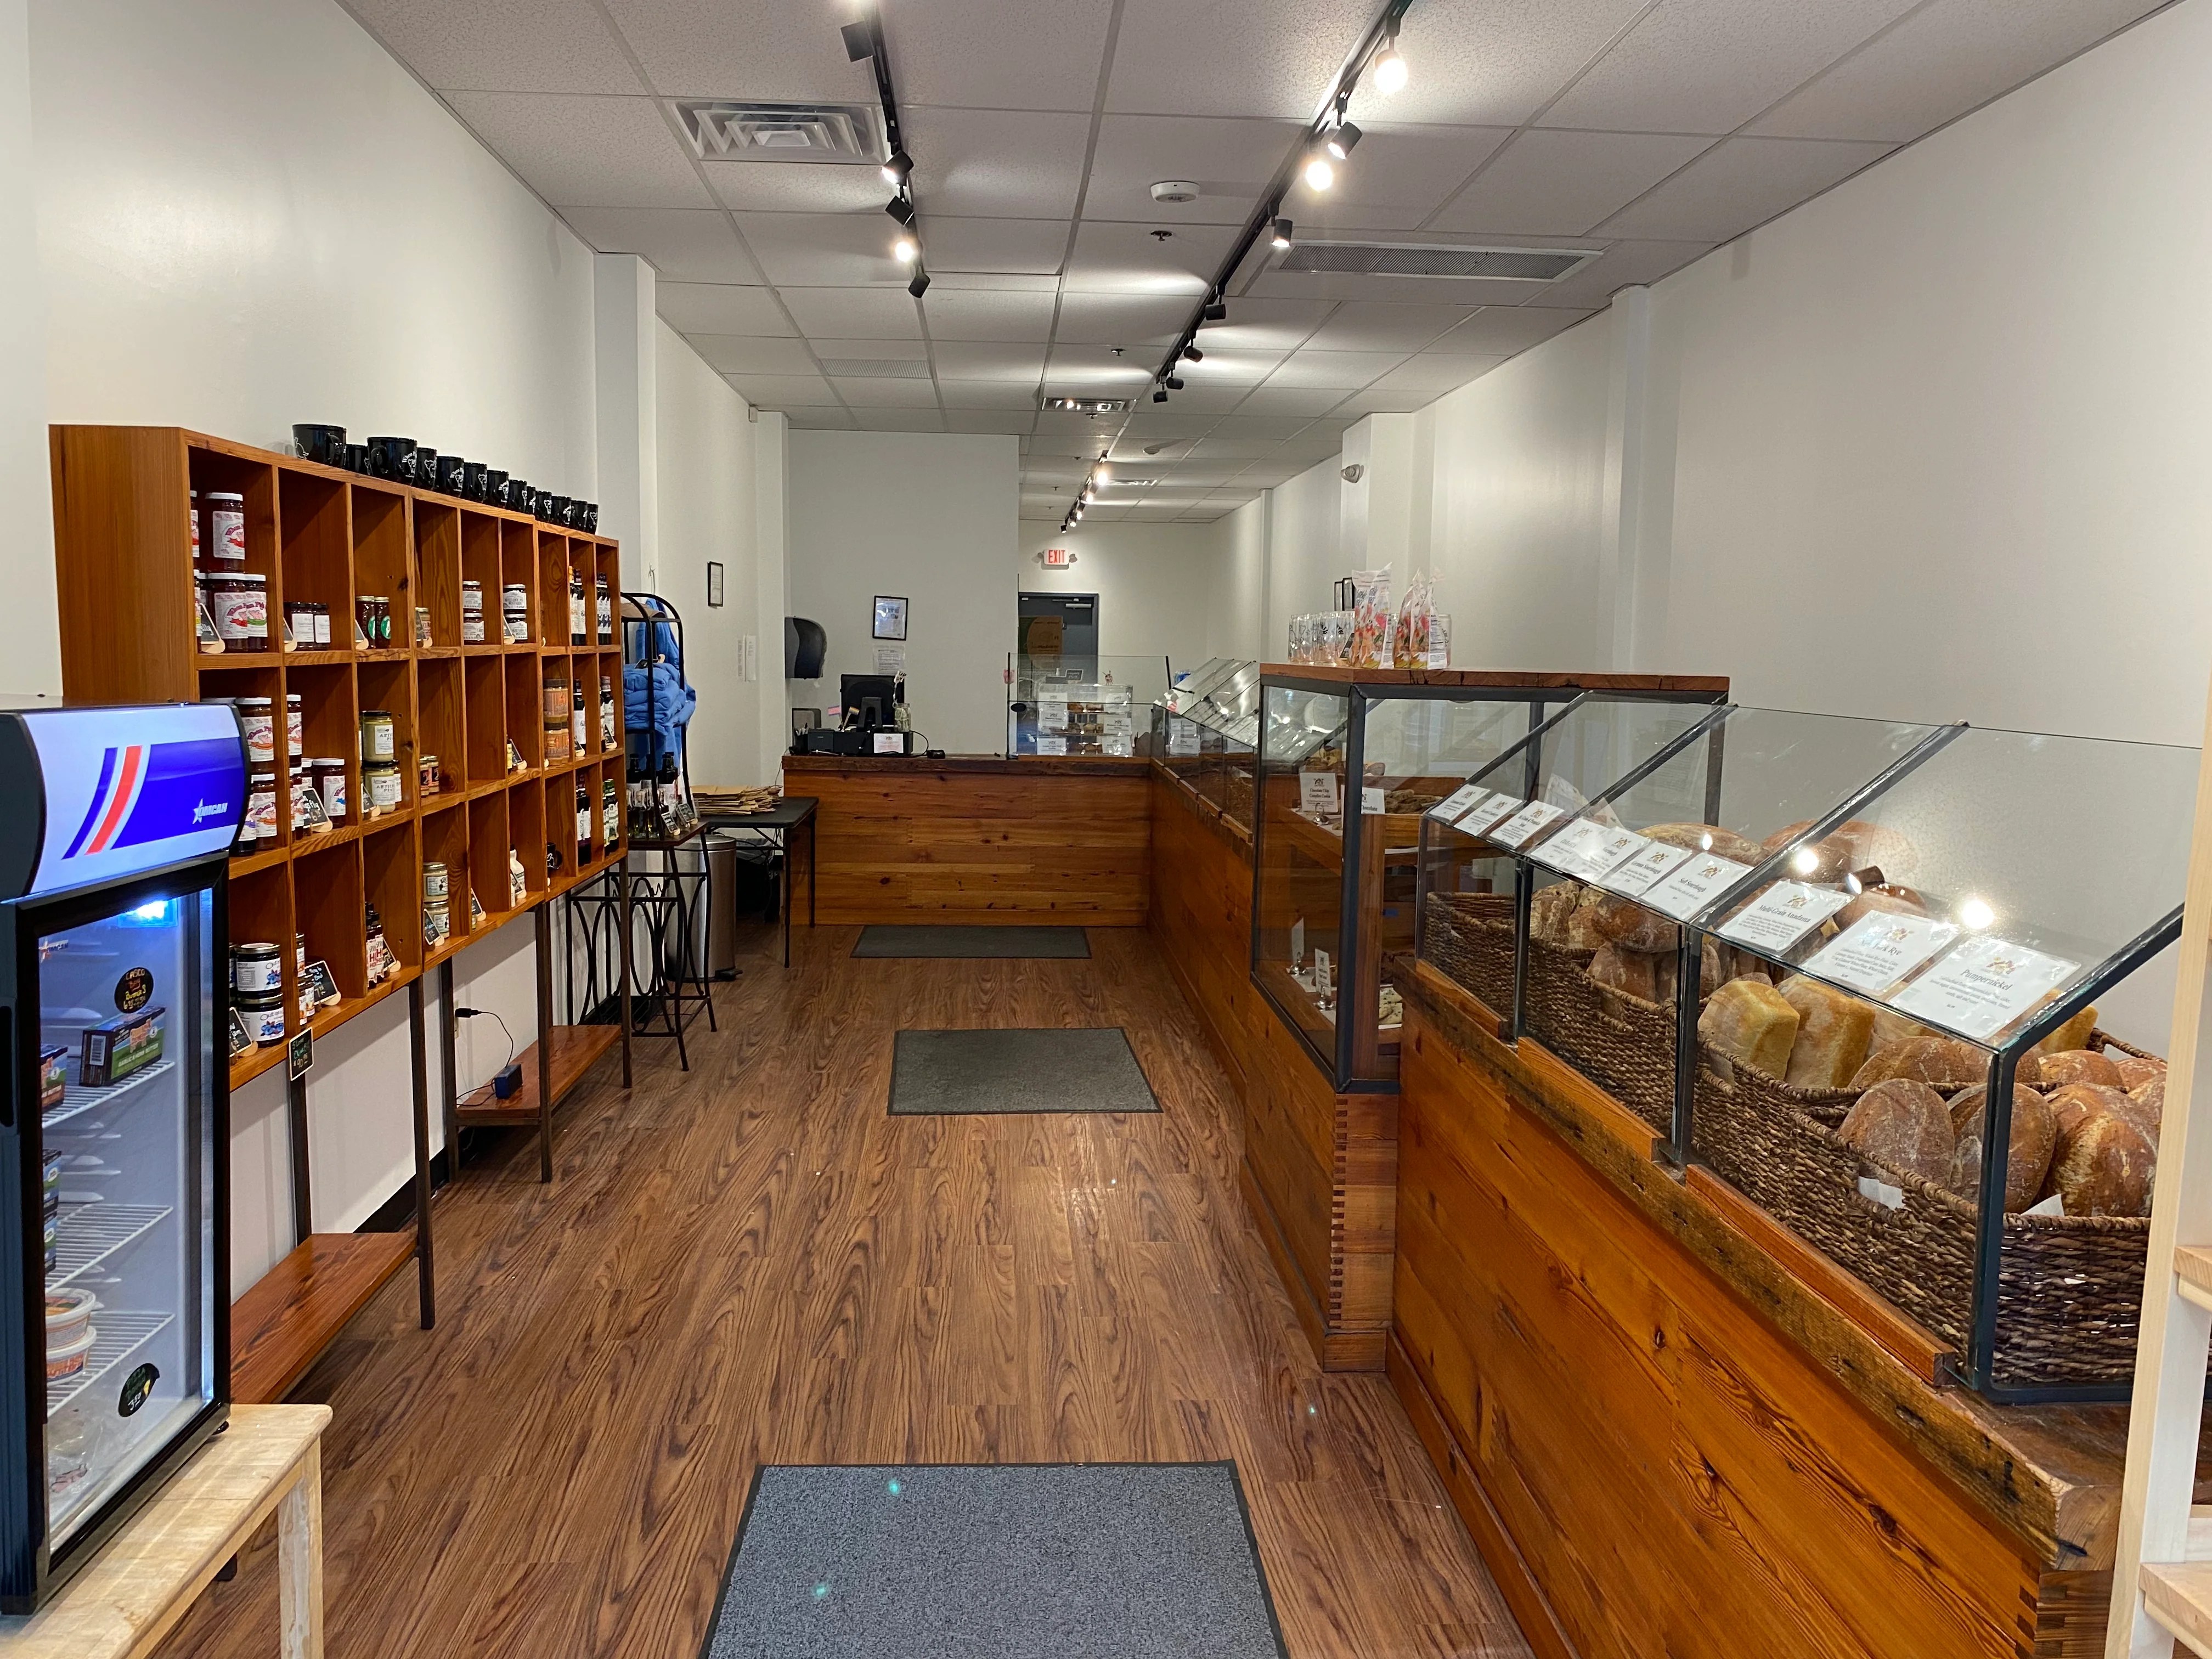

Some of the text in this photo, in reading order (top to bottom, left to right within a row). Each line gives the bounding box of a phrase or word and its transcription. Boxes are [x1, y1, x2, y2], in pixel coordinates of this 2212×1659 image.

[1048, 550, 1065, 563] EXIT
[198, 803, 228, 817] OMCAN
[1759, 905, 1812, 923] Multi-Grain Anadama
[1887, 947, 1902, 956] Rye
[1960, 969, 2013, 991] Pumpernickel
